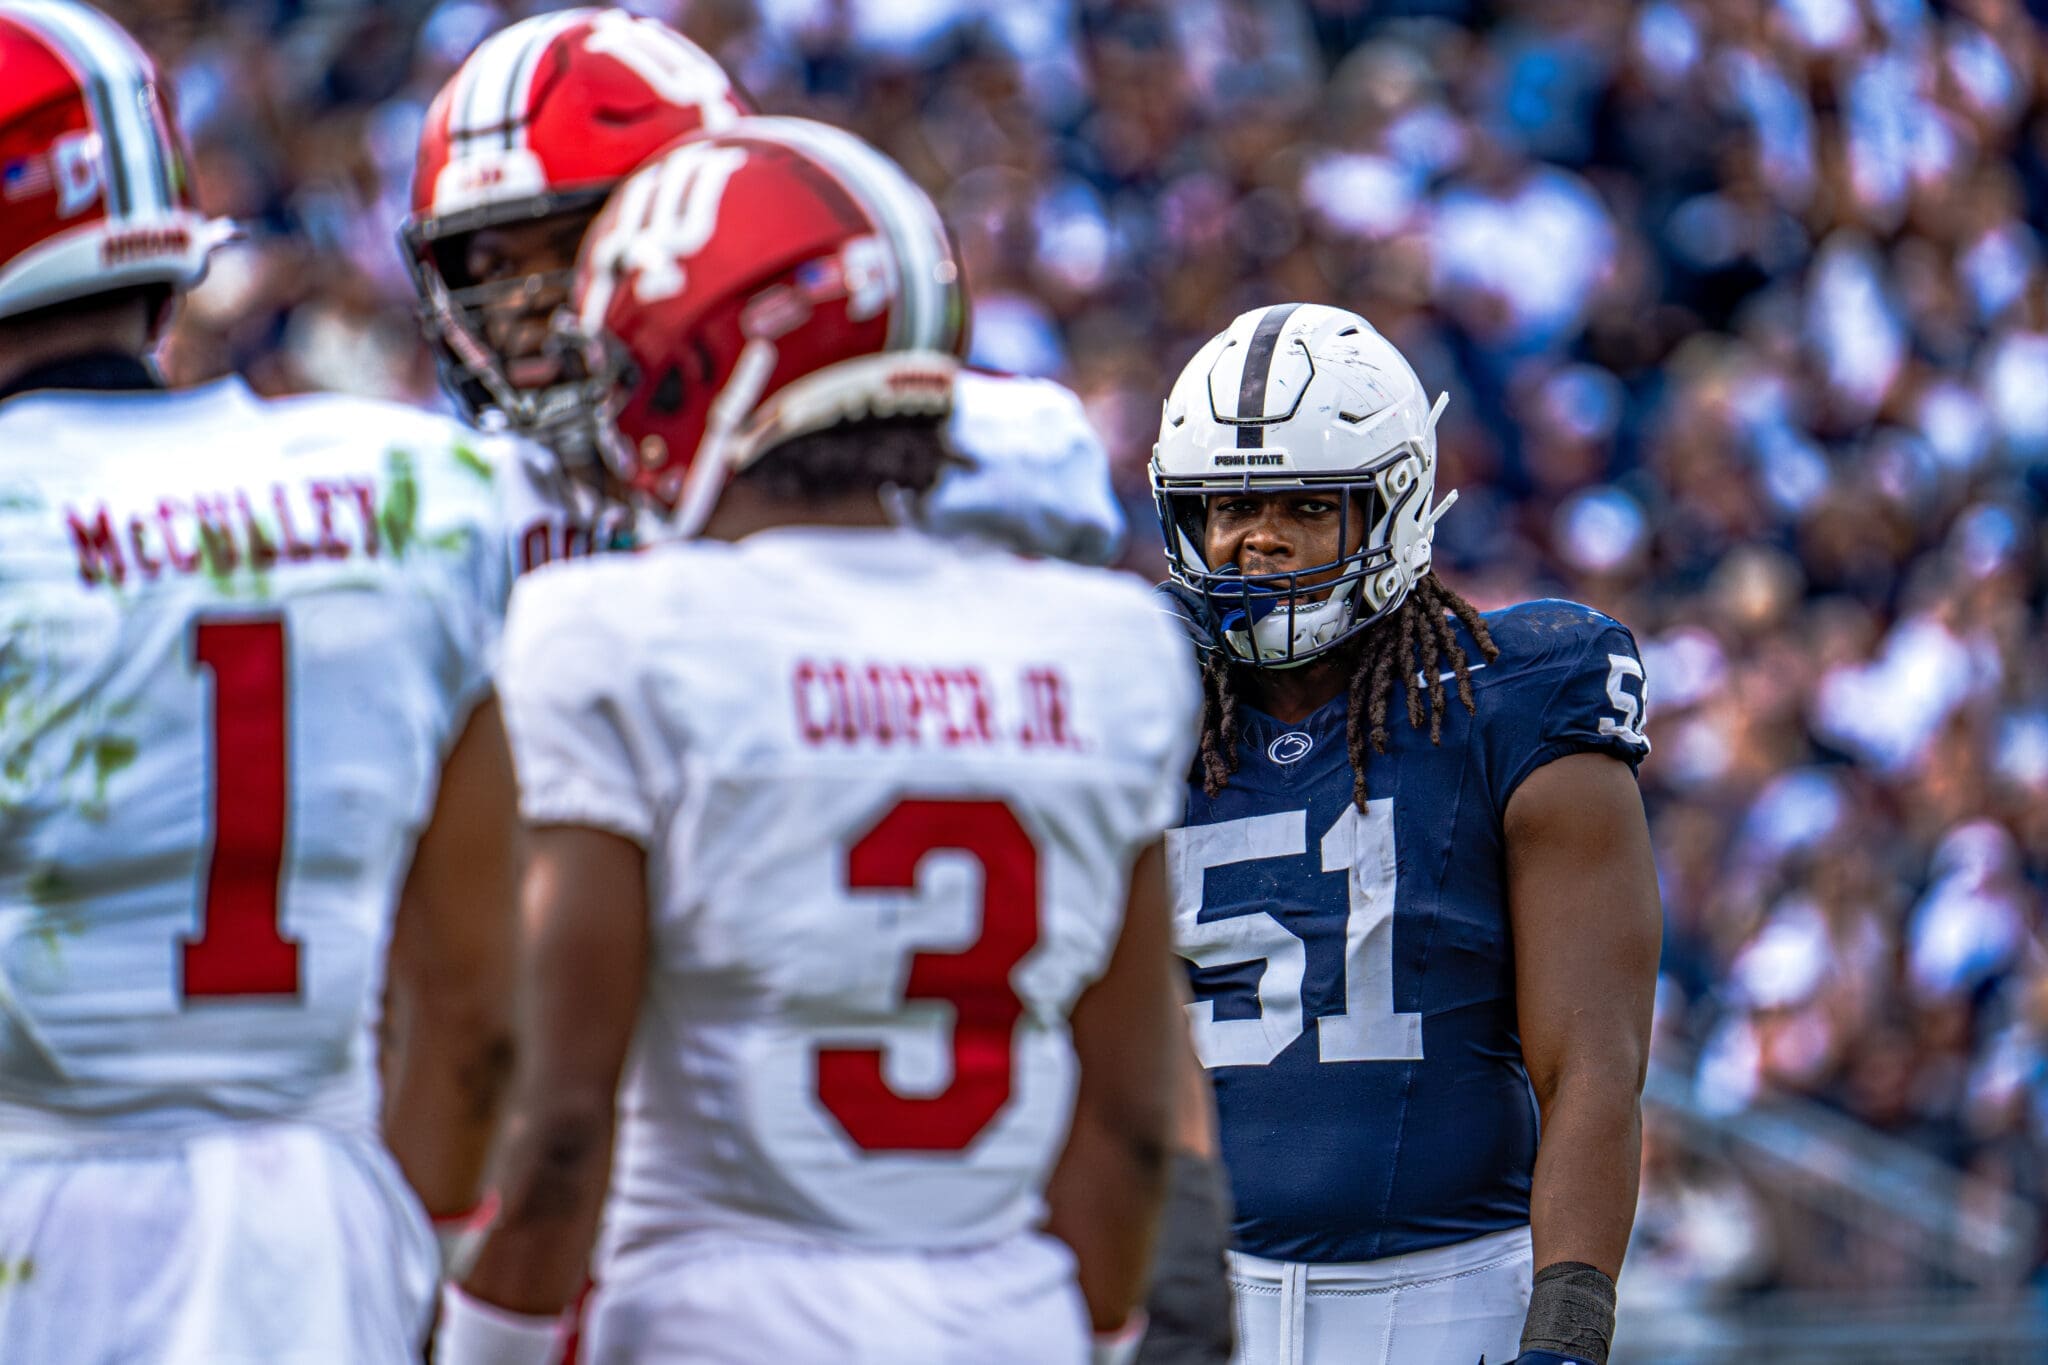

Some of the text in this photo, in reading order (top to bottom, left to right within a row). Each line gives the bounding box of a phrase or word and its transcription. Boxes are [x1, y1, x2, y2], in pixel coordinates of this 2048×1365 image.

[1214, 454, 1284, 466] PENN STATE
[183, 617, 304, 1002] 1
[795, 660, 992, 746] COOPER
[812, 794, 1042, 1156] 3
[1165, 797, 1425, 1069] 51
